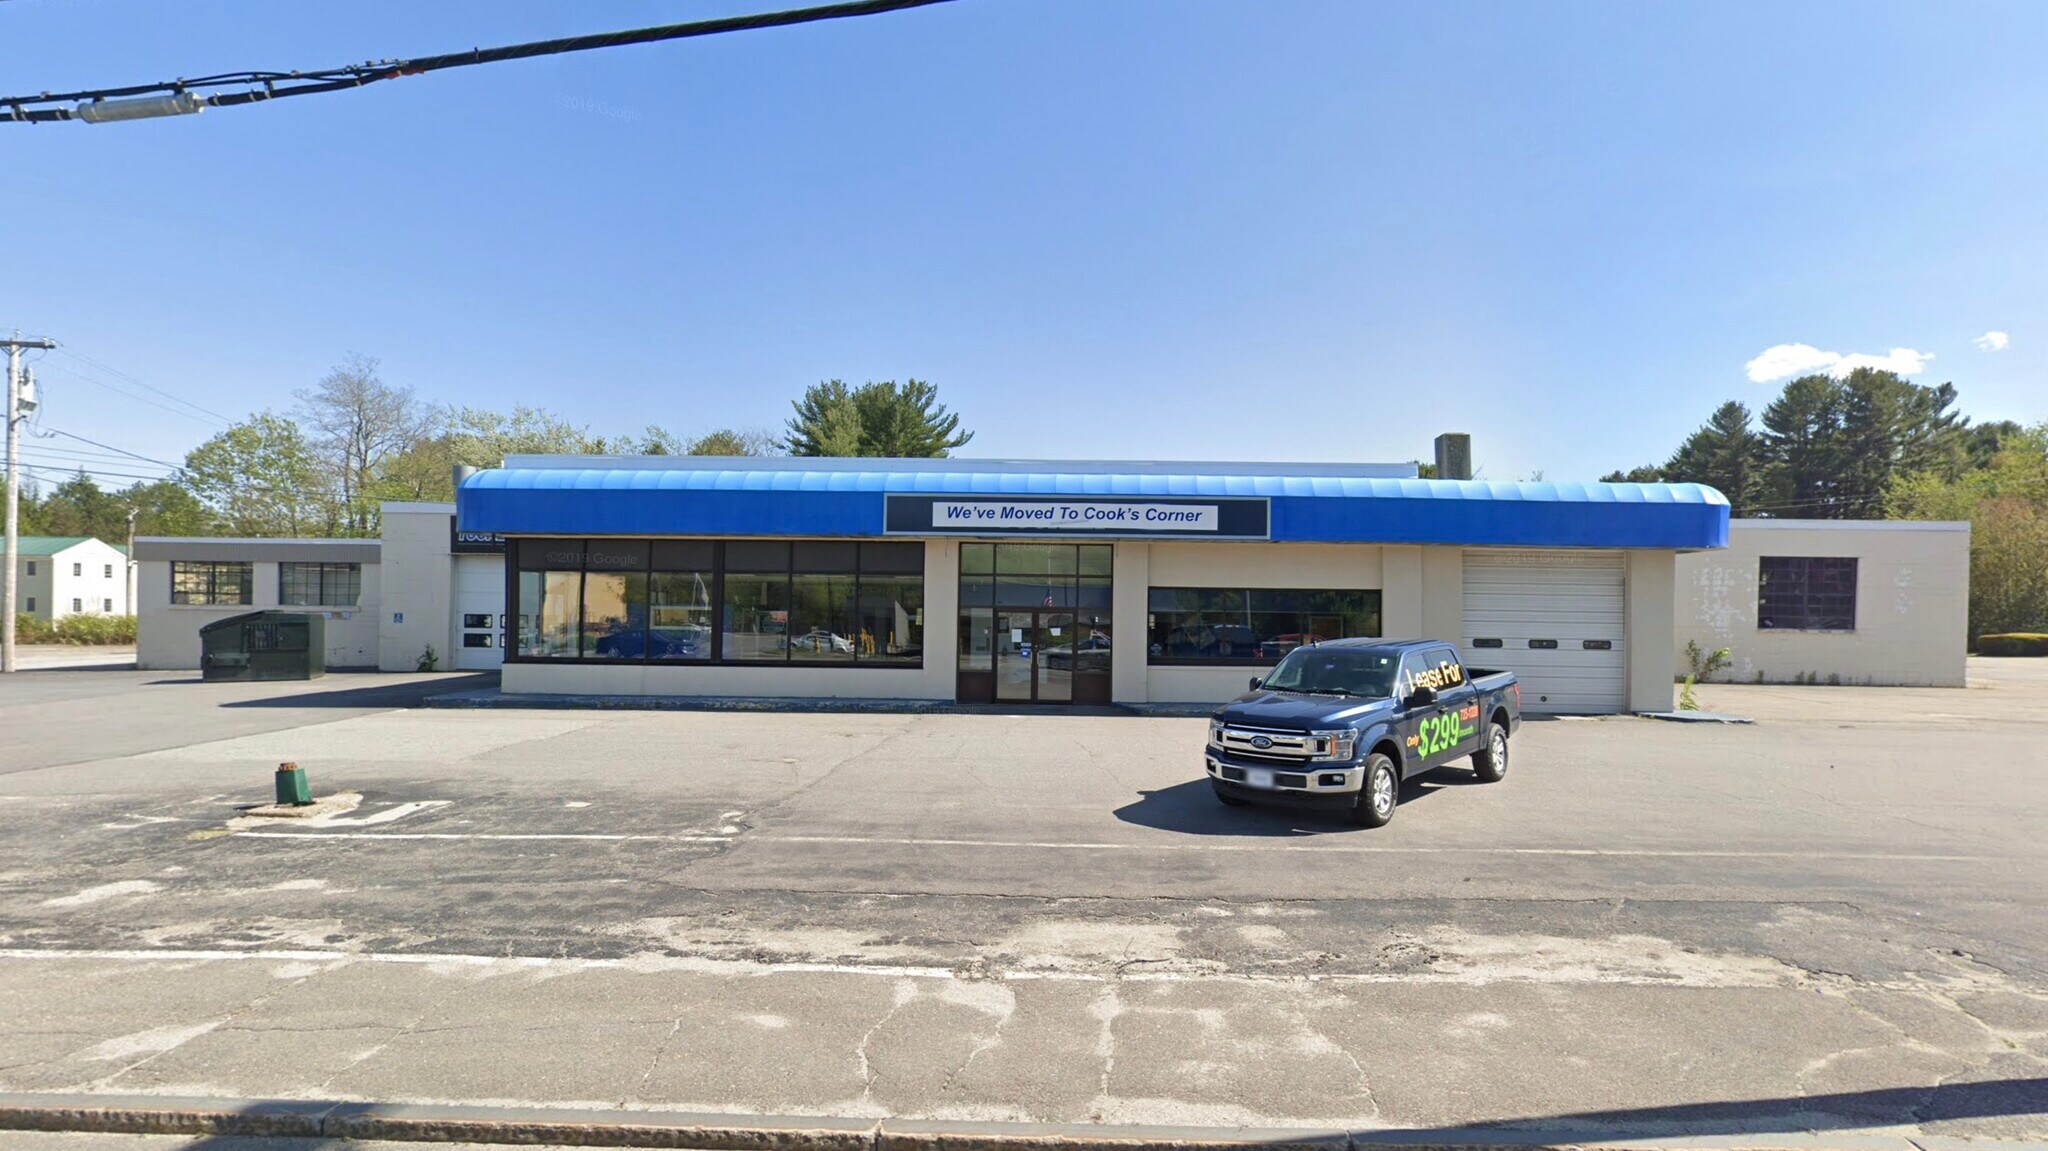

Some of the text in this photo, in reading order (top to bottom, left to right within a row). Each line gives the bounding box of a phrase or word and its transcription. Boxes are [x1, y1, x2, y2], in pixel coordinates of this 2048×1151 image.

[947, 506, 1203, 522] We've Moved To Cook's Corner
[1405, 660, 1462, 692] Lease For
[1418, 711, 1460, 761] $299
